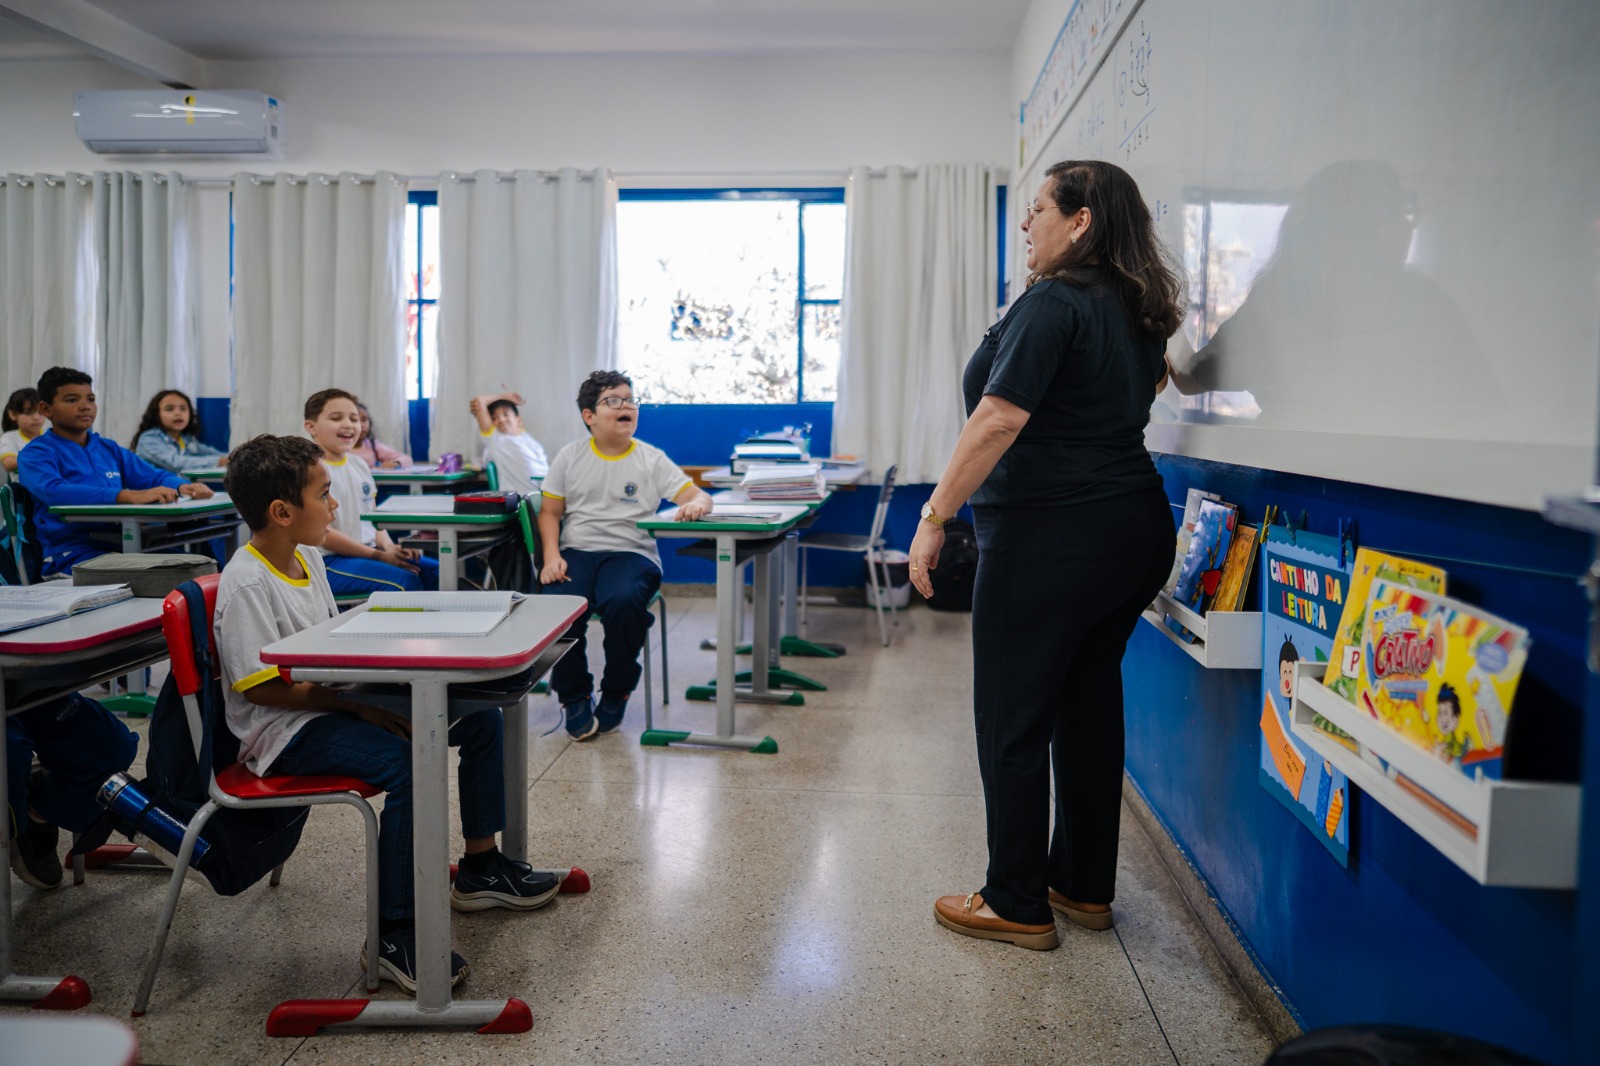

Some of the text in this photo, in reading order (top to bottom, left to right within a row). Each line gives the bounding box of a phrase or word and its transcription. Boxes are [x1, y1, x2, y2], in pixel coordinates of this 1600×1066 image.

[1270, 558, 1342, 605] CANTINHO DA
[1282, 590, 1327, 631] LEITURA
